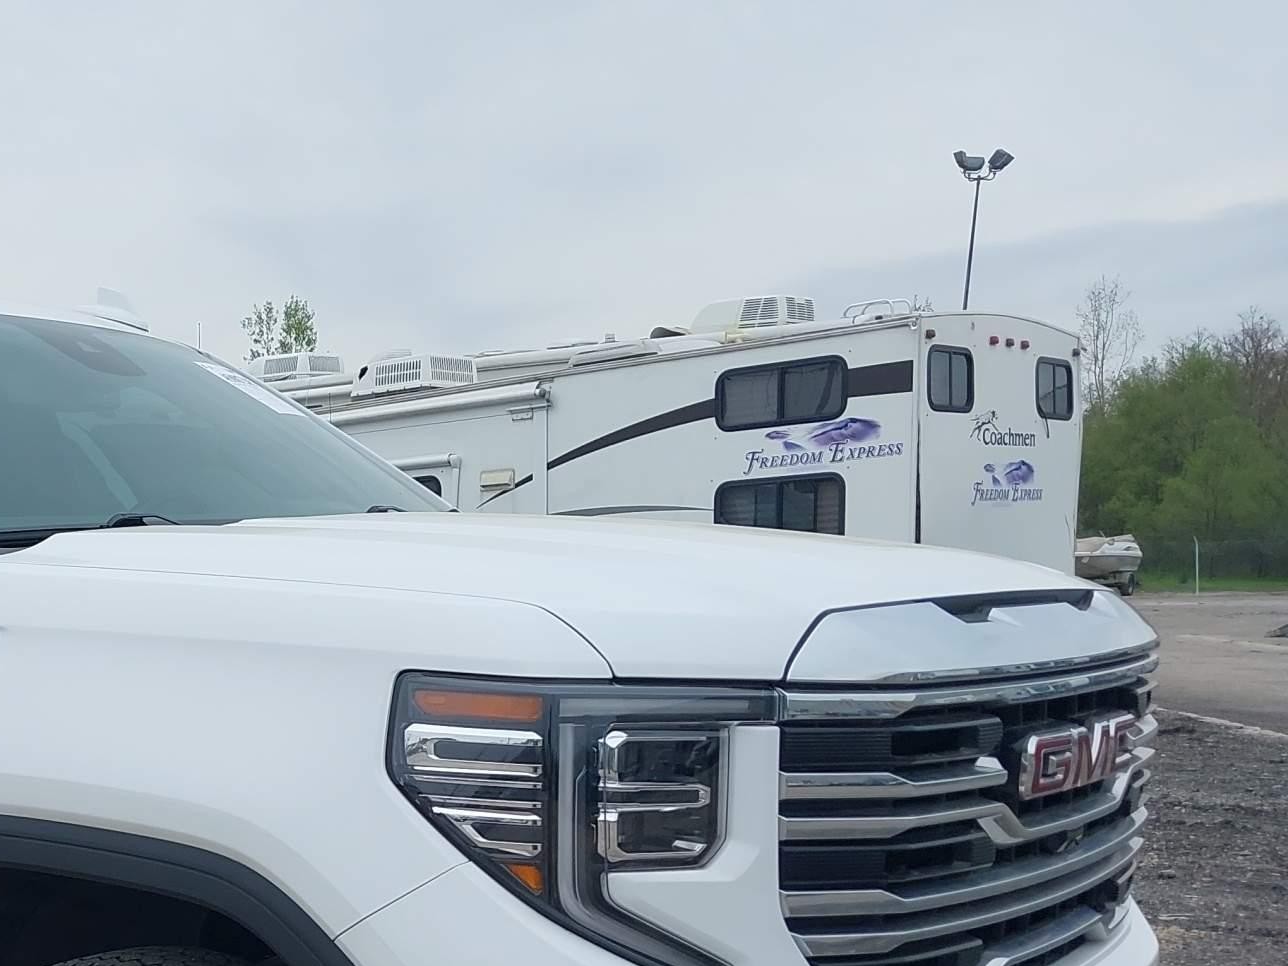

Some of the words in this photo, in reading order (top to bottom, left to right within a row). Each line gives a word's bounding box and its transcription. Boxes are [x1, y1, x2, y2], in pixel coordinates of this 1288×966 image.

[982, 427, 1036, 447] Coachmen
[743, 448, 823, 476] FREEDOM
[829, 439, 904, 464] EXPRESS
[1019, 713, 1136, 800] GMC
